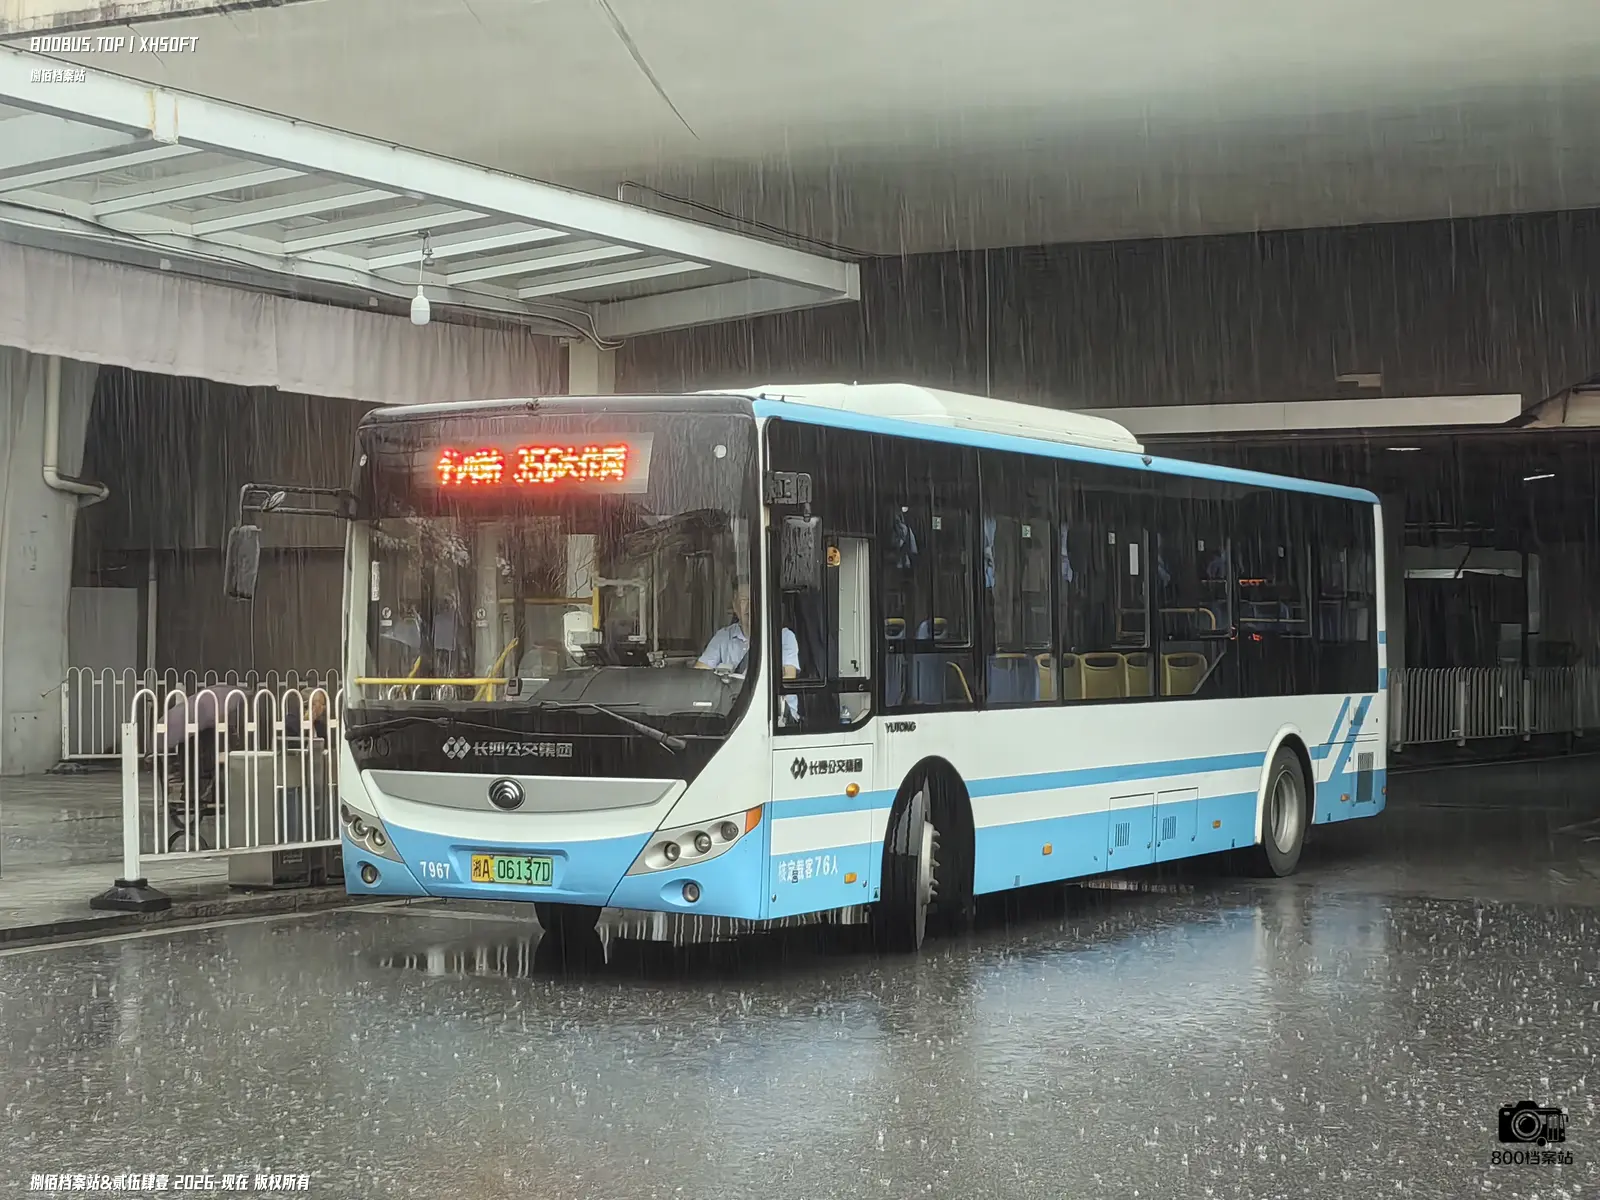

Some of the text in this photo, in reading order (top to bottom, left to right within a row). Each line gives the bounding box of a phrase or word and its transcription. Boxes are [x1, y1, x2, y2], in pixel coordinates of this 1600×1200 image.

[884, 721, 917, 733] YUTONG
[472, 742, 573, 758] 长沙公交集团
[420, 861, 450, 880] 7967
